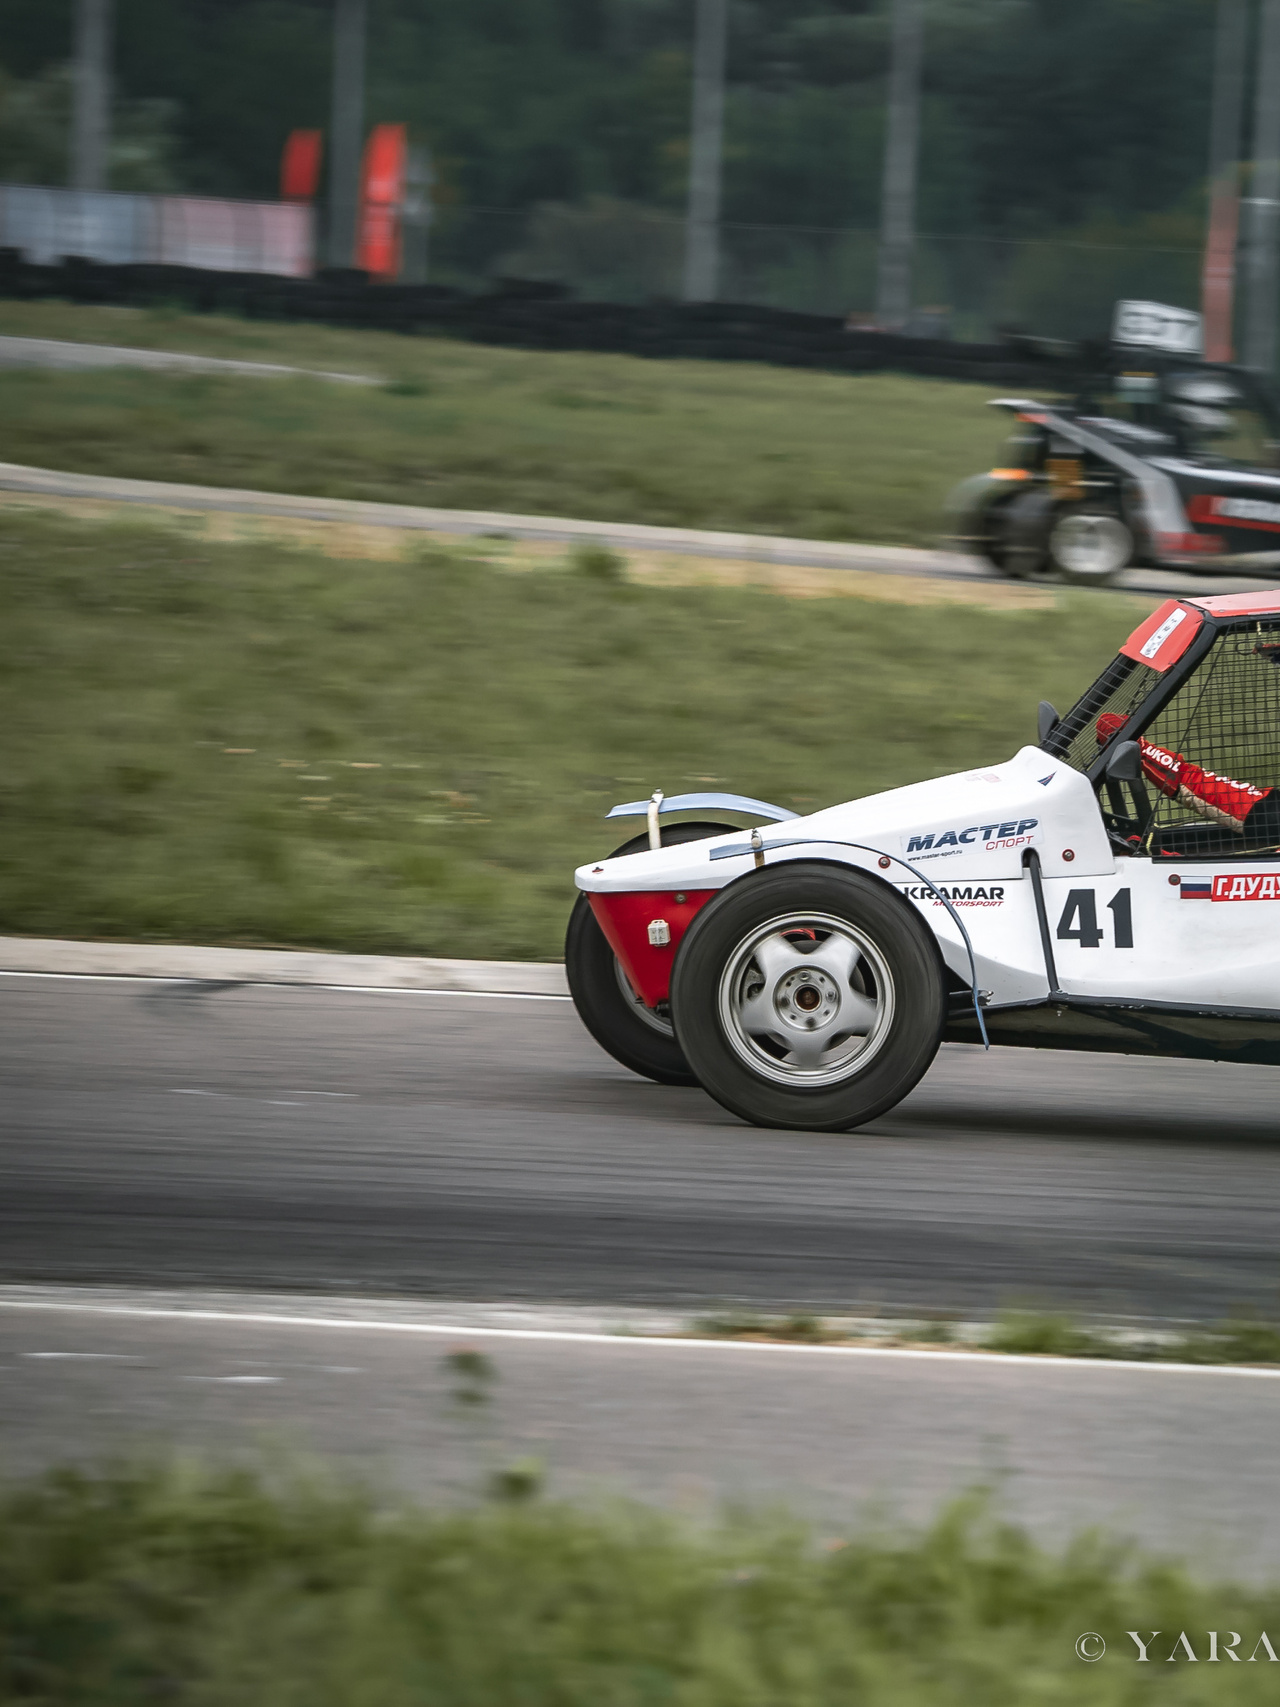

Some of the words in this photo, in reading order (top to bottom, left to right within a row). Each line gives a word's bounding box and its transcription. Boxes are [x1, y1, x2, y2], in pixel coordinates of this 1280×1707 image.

[1141, 745, 1181, 772] UKOIL
[906, 818, 1039, 852] МАСТЕР
[985, 835, 1035, 851] СПОРТ
[907, 849, 963, 861] www.master-sport.ru
[904, 886, 1004, 900] KRAMAR
[1056, 887, 1134, 949] 41
